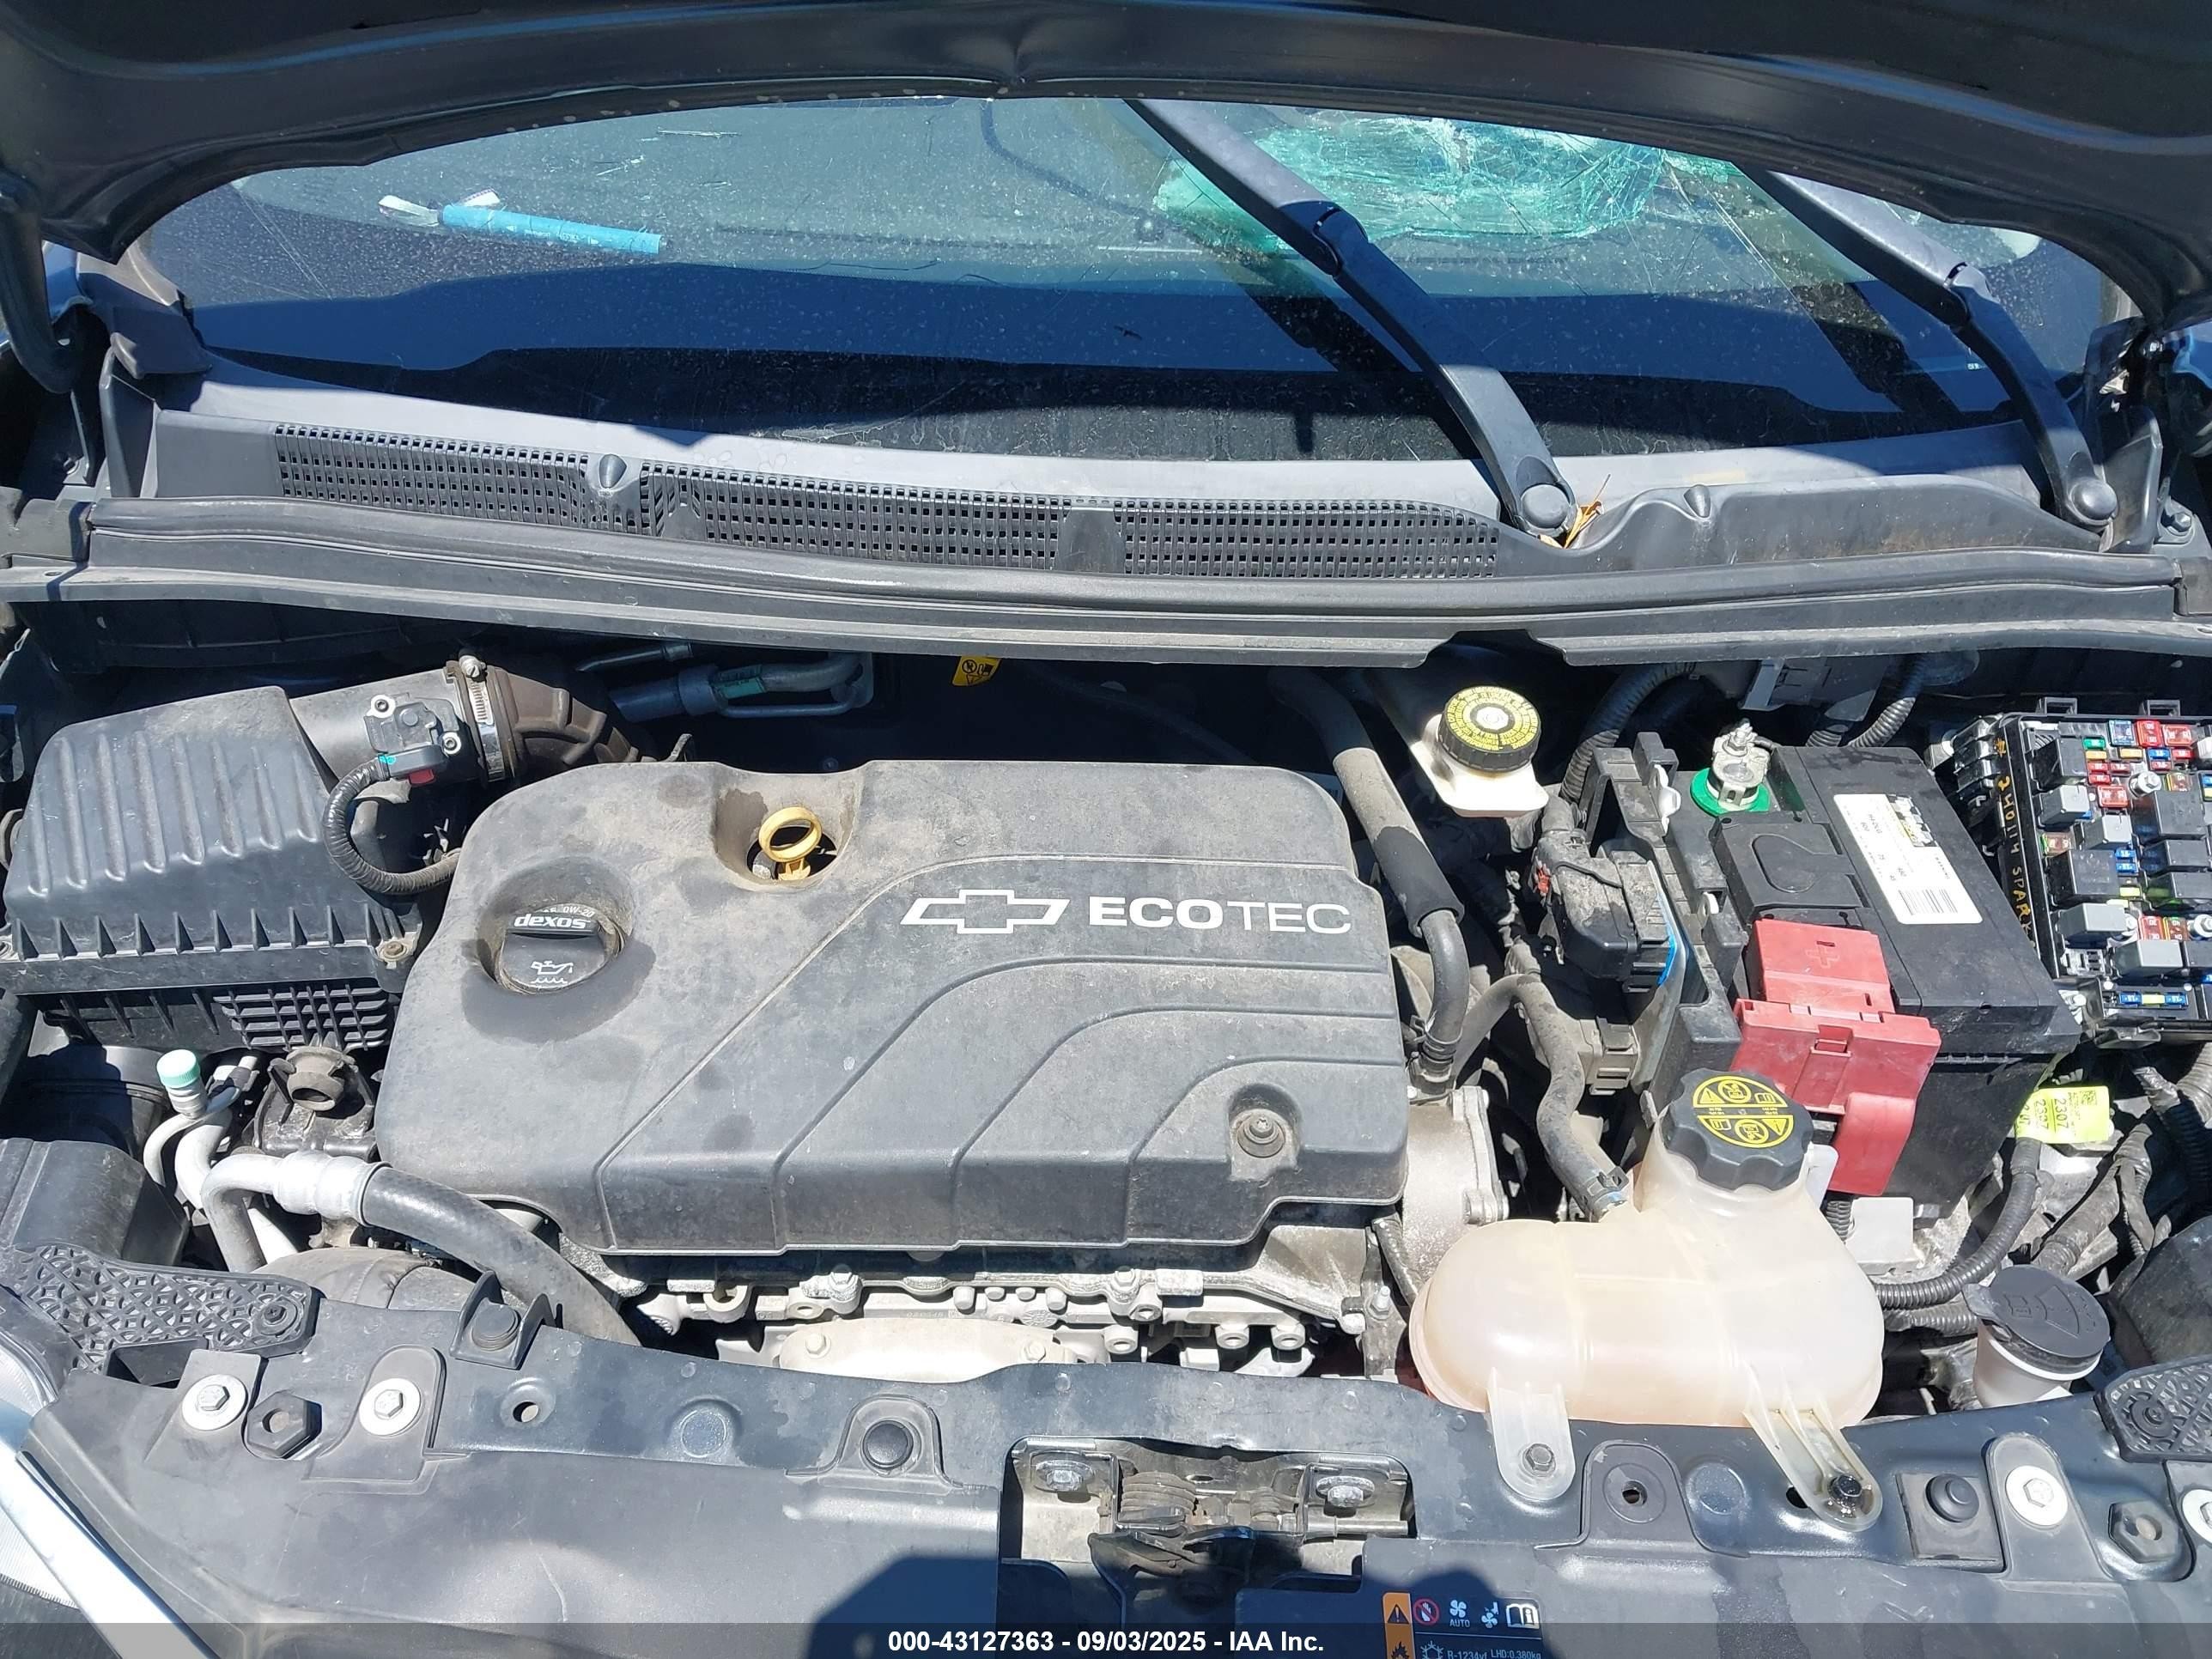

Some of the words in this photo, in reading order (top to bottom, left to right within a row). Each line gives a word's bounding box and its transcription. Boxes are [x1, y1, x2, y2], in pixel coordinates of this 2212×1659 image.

[562, 906, 596, 918] 0W-20
[1089, 896, 1352, 934] ECOTEC
[514, 913, 592, 929] dexos
[2054, 1098, 2069, 1129] 2307
[1449, 1619, 1470, 1628] AUTO
[1447, 1650, 1488, 1659] R-1234yf
